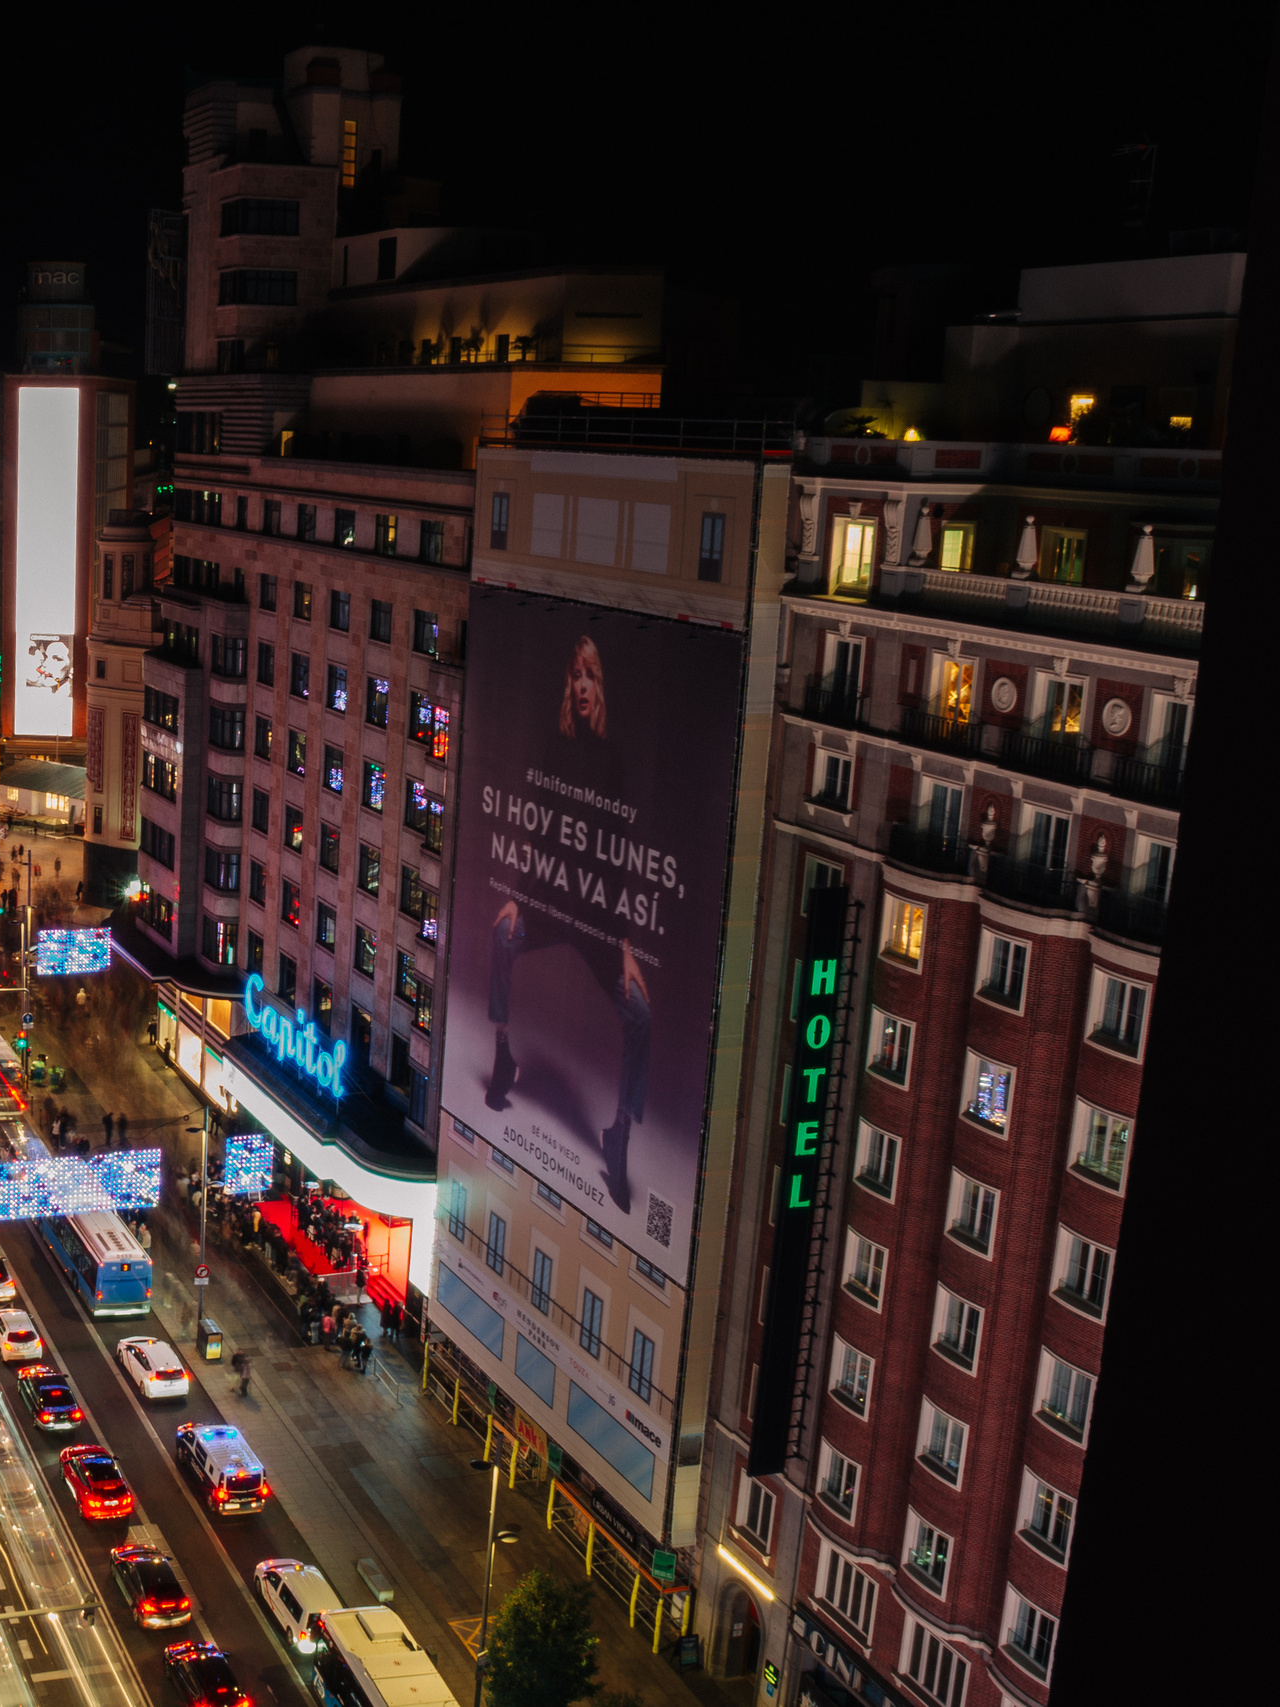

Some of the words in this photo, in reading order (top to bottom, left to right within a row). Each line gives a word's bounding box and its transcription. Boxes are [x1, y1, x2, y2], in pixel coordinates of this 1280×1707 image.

[32, 268, 80, 285] fnac
[526, 768, 637, 823] #UniformMonday
[482, 785, 500, 817] SI
[507, 794, 553, 836] HOY
[560, 814, 588, 851] ES
[596, 828, 685, 899] LUNES,
[491, 832, 569, 892] NAJWA
[577, 868, 607, 909] VA
[614, 887, 665, 935] ASÍ.
[529, 898, 547, 912] para
[548, 905, 574, 925] liberar
[574, 919, 606, 941] espacio
[606, 934, 618, 947] en
[245, 973, 347, 1098] Capitol
[789, 959, 837, 1208] HOTEL
[531, 1125, 541, 1138] SÉ
[542, 1132, 558, 1150] MÁS
[558, 1144, 581, 1166] VIEJO
[517, 1309, 560, 1351] HENDERSON
[528, 1328, 547, 1350] PARK
[634, 1417, 662, 1449] mace
